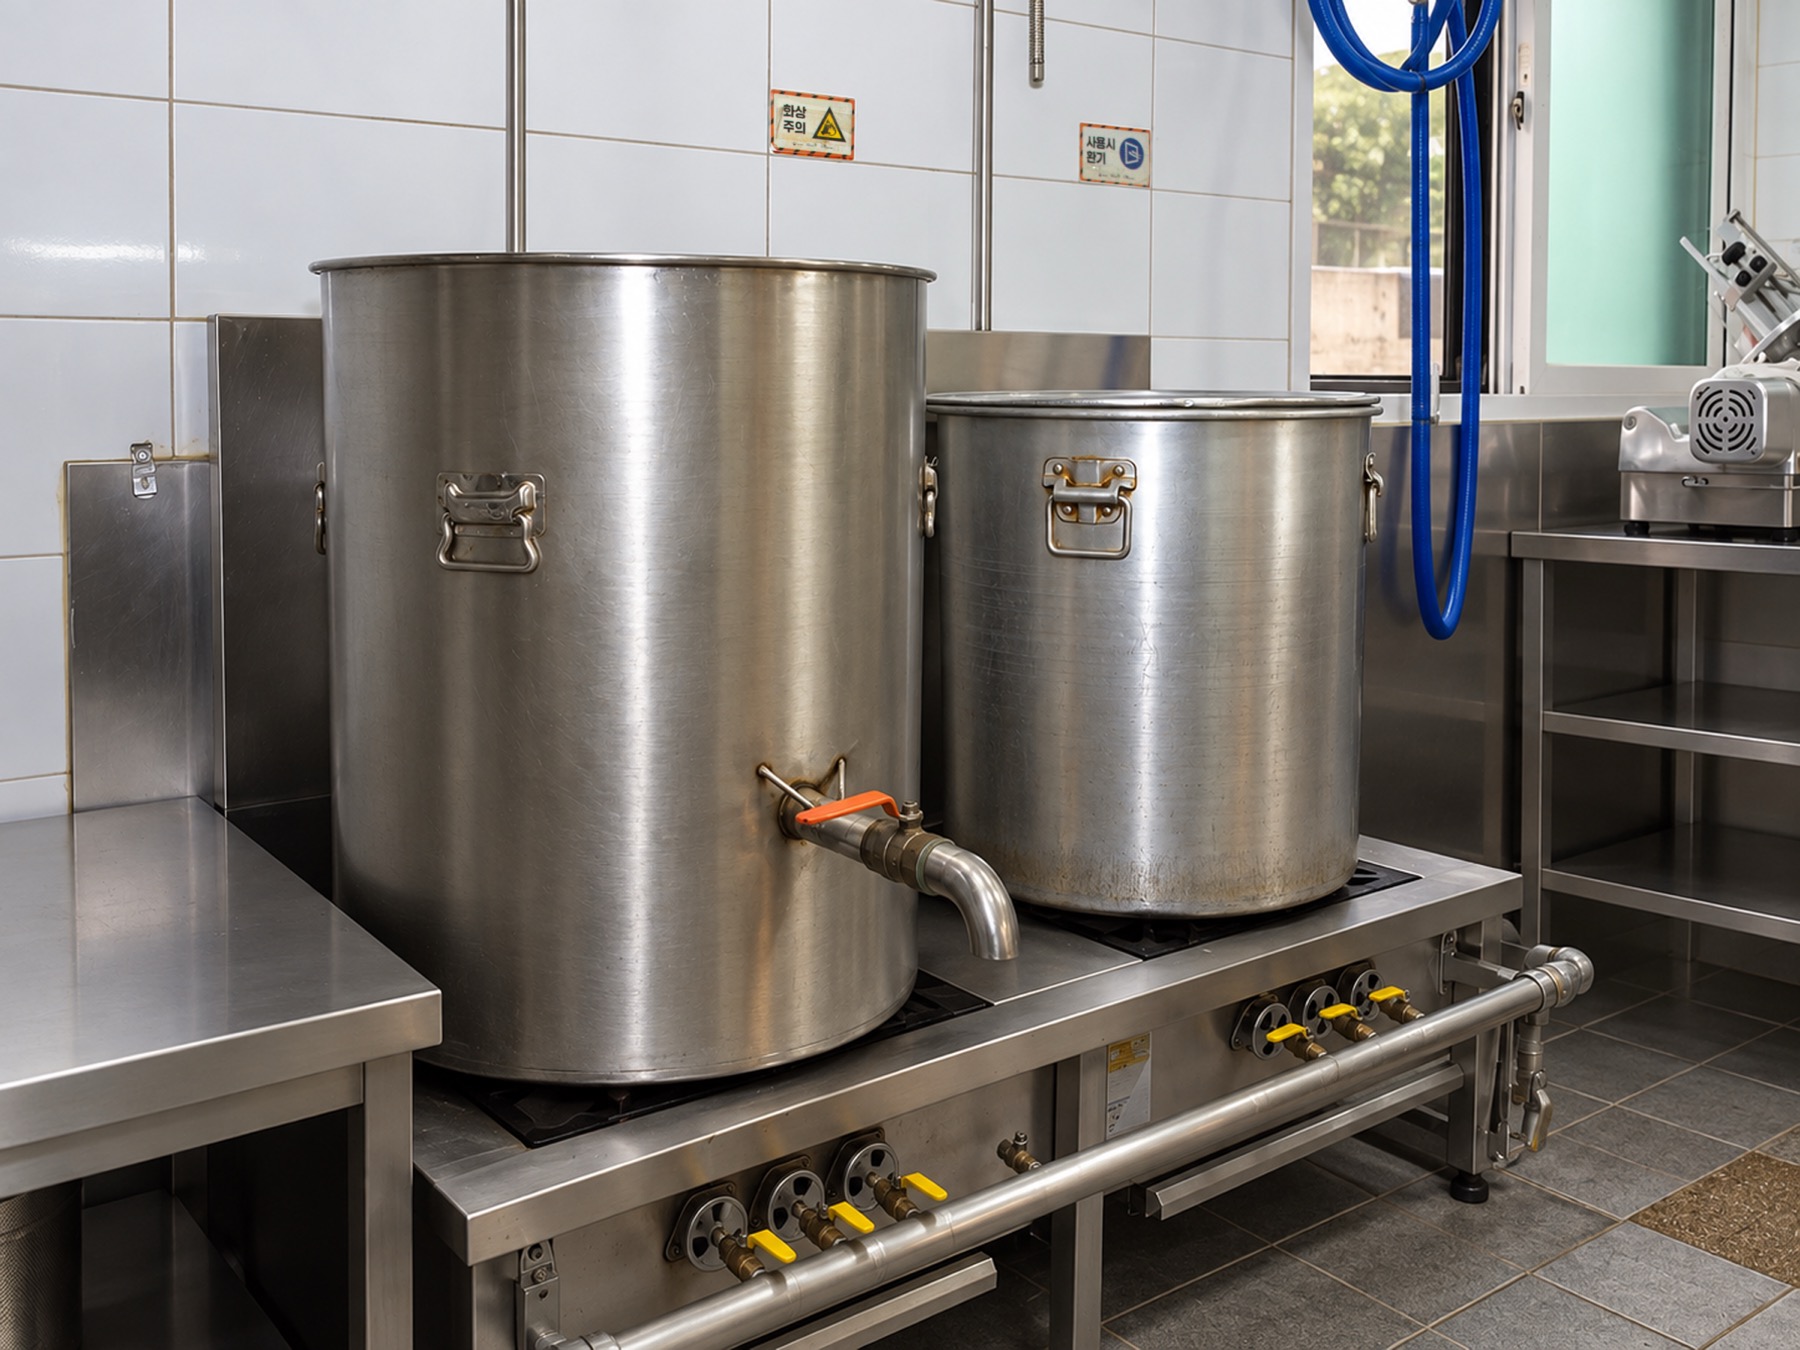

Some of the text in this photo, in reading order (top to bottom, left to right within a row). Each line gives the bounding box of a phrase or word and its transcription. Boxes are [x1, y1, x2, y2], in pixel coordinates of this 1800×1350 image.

[783, 104, 807, 119] 화상
[783, 120, 806, 134] 주의
[1086, 136, 1115, 150] 사용시
